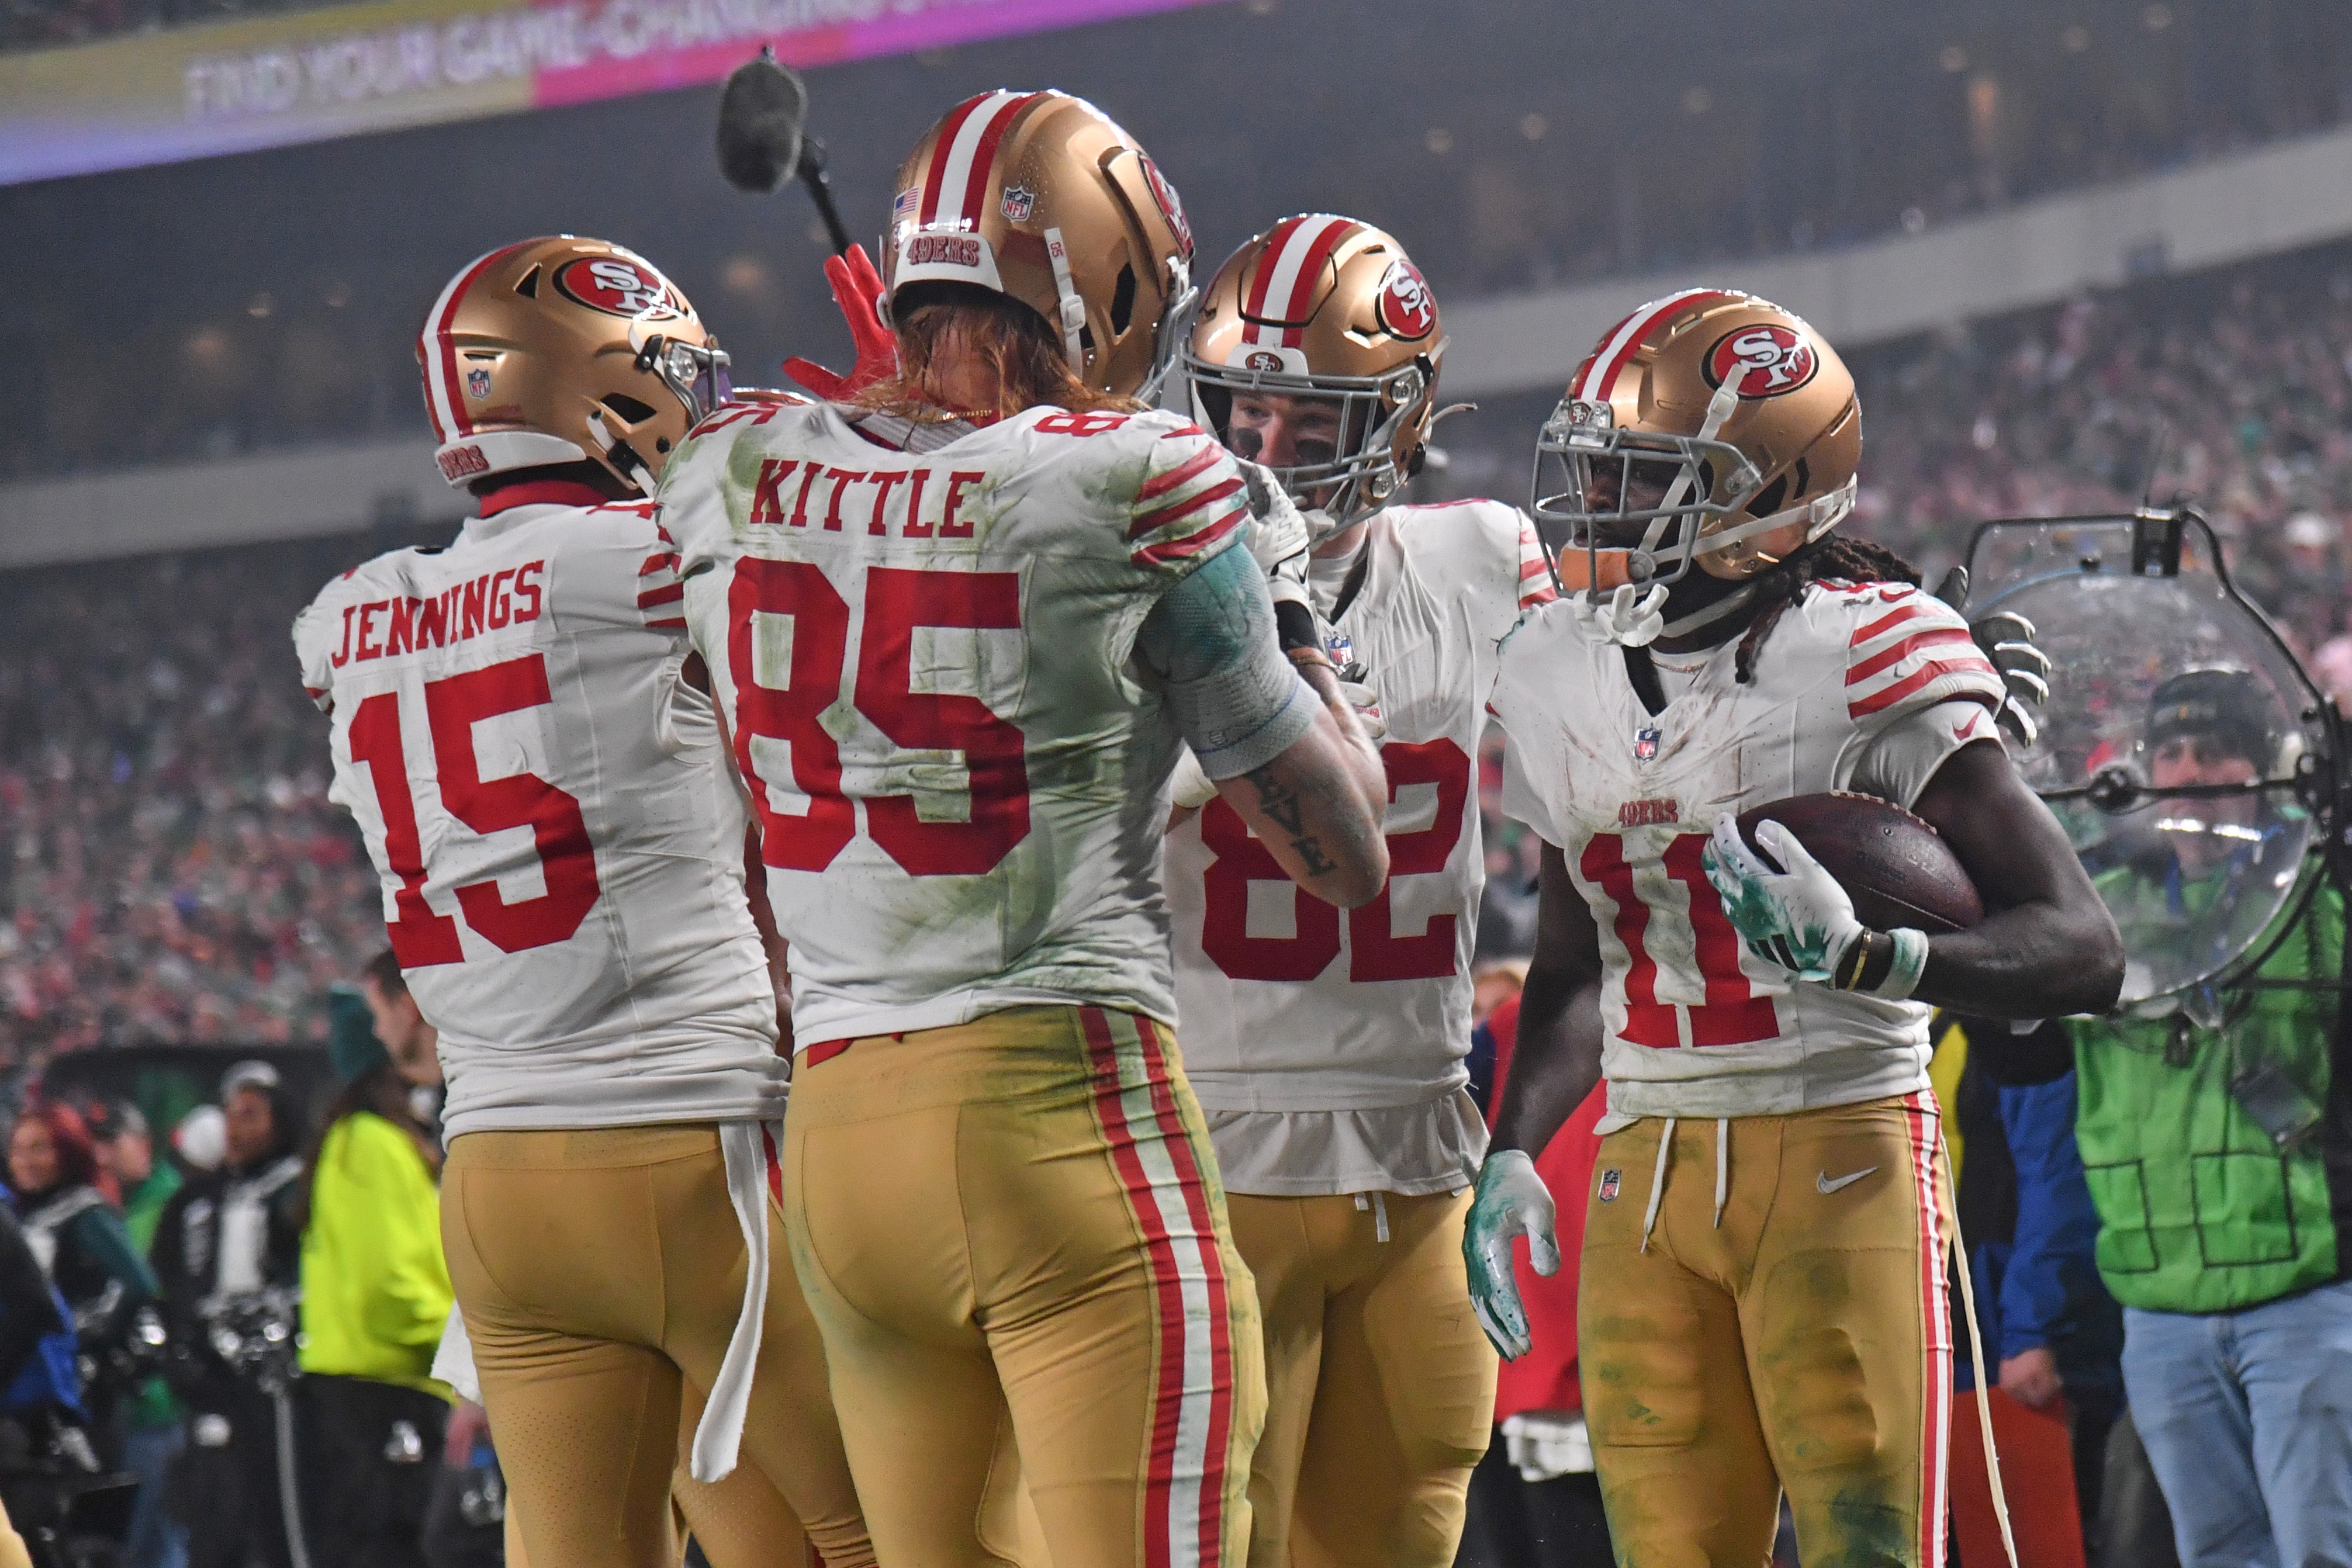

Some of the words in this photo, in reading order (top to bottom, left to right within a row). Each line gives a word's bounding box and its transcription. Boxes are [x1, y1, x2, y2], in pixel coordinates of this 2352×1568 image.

[907, 236, 980, 267] 49ERS
[1004, 200, 1026, 218] NFL
[749, 458, 986, 538] KITTLE
[331, 559, 545, 669] JENNINGS
[728, 555, 1031, 876] 85
[349, 652, 601, 969] 15
[1202, 736, 1471, 982] 82
[1618, 799, 1678, 829] 49ERS
[1580, 833, 1780, 1048] 11
